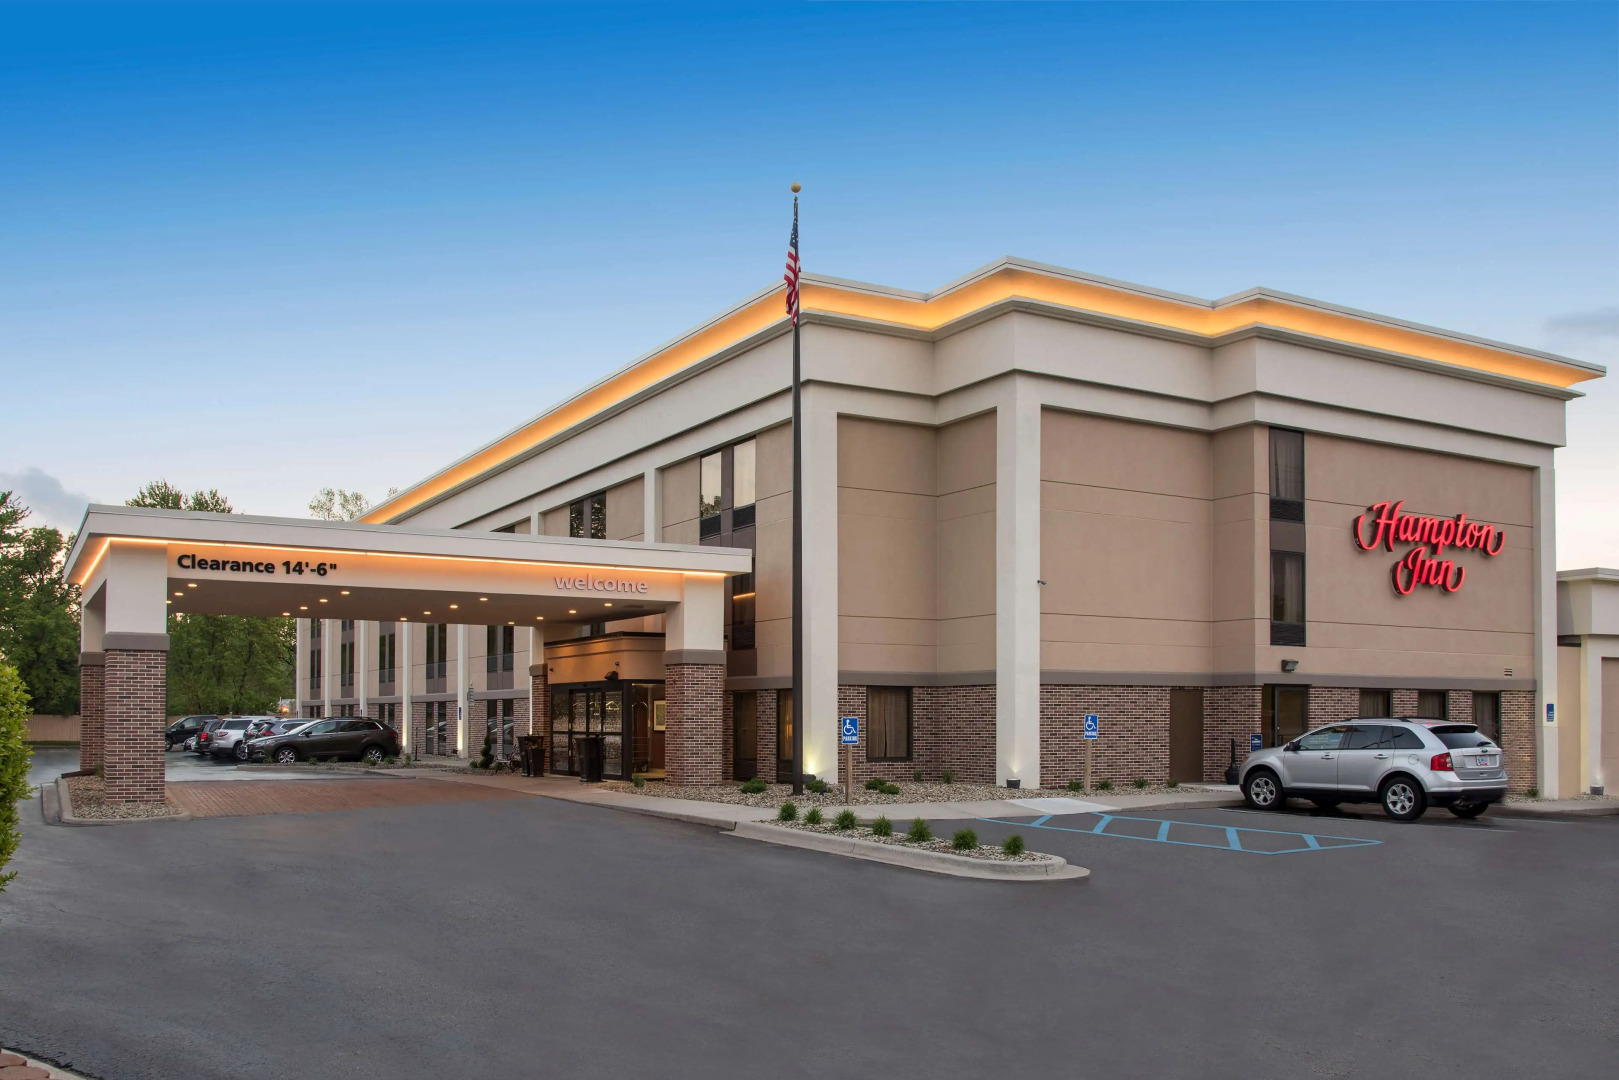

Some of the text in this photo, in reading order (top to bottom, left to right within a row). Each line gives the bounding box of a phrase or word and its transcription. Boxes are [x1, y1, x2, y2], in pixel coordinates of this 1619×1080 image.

[1353, 500, 1505, 556] Hampton
[177, 554, 337, 577] Clearance 14'-6"
[554, 573, 648, 593] welcome
[1391, 546, 1464, 595] Inn
